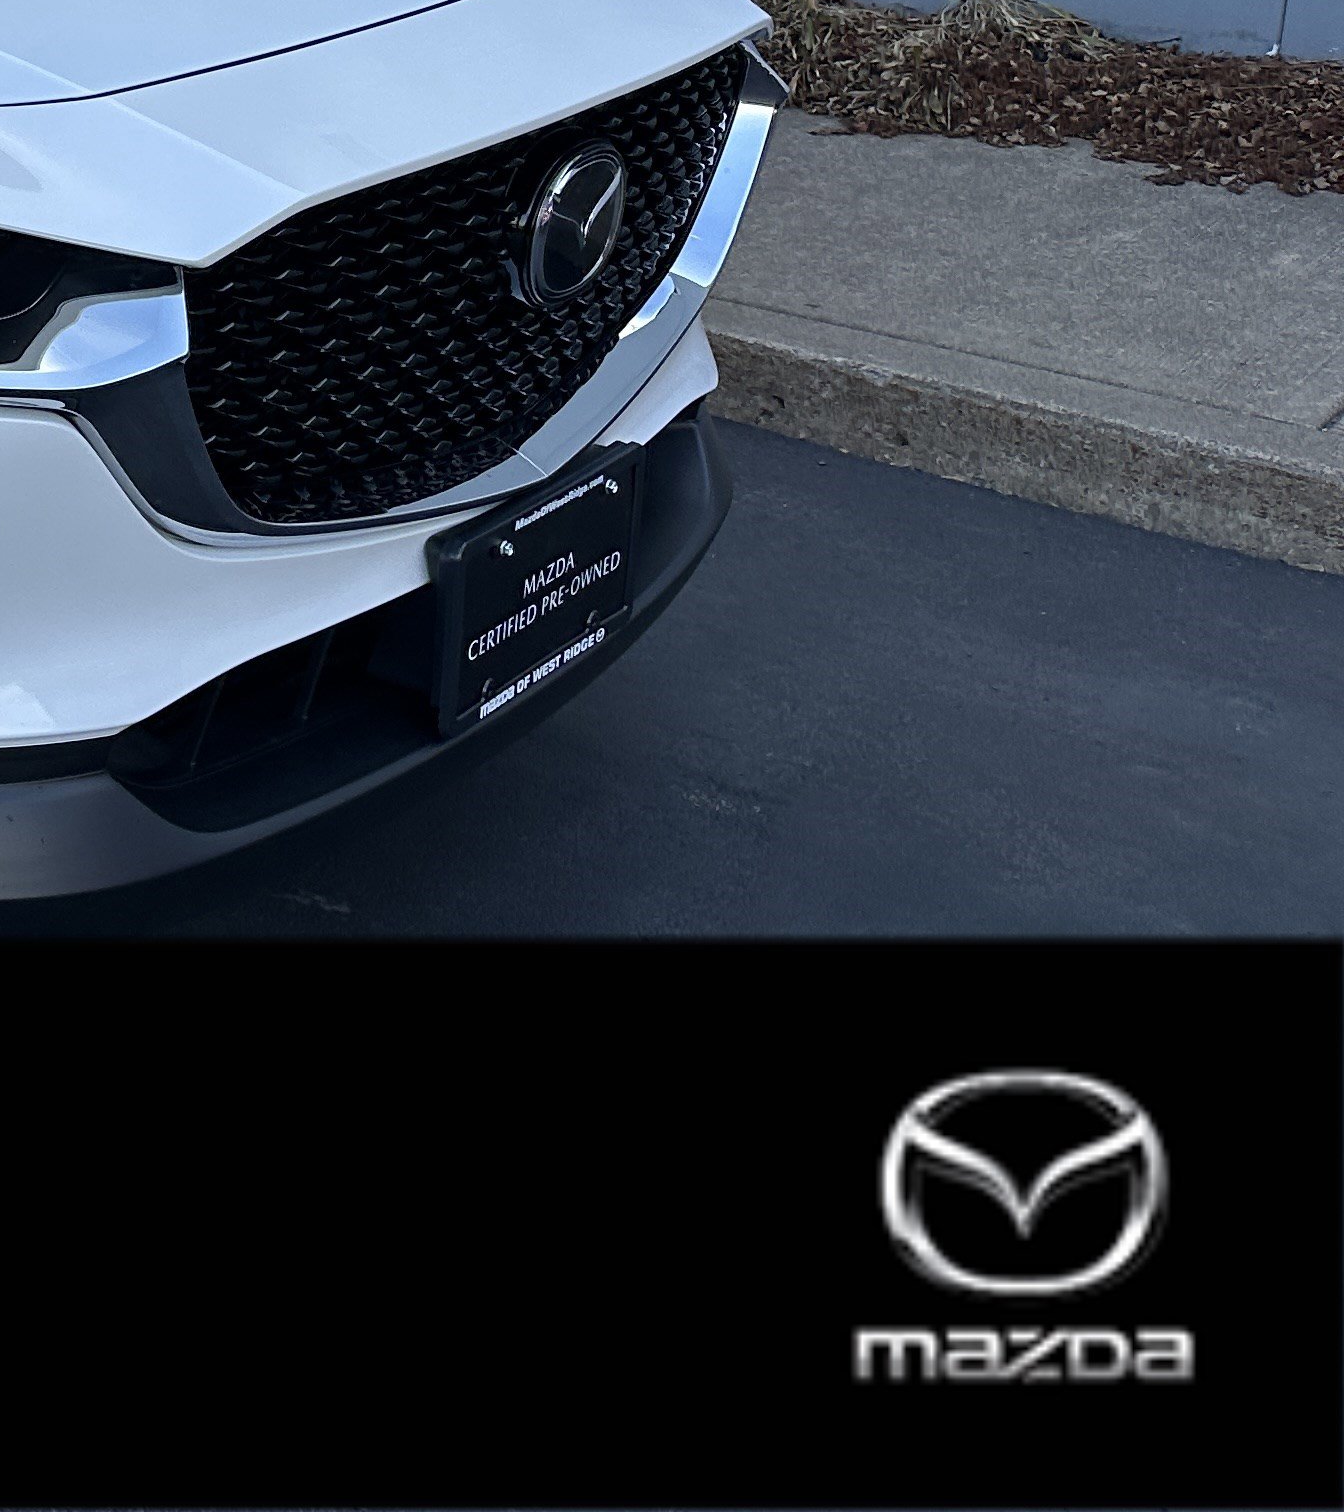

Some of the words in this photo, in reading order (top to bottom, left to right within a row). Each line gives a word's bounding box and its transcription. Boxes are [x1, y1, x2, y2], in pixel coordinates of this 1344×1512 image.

[522, 551, 575, 599] MAZDA
[467, 604, 537, 661] CERTIFIED
[541, 551, 621, 616] PRE-OWNED
[516, 674, 531, 694] OF
[532, 654, 562, 684] WEST
[563, 633, 595, 664] RIDGE
